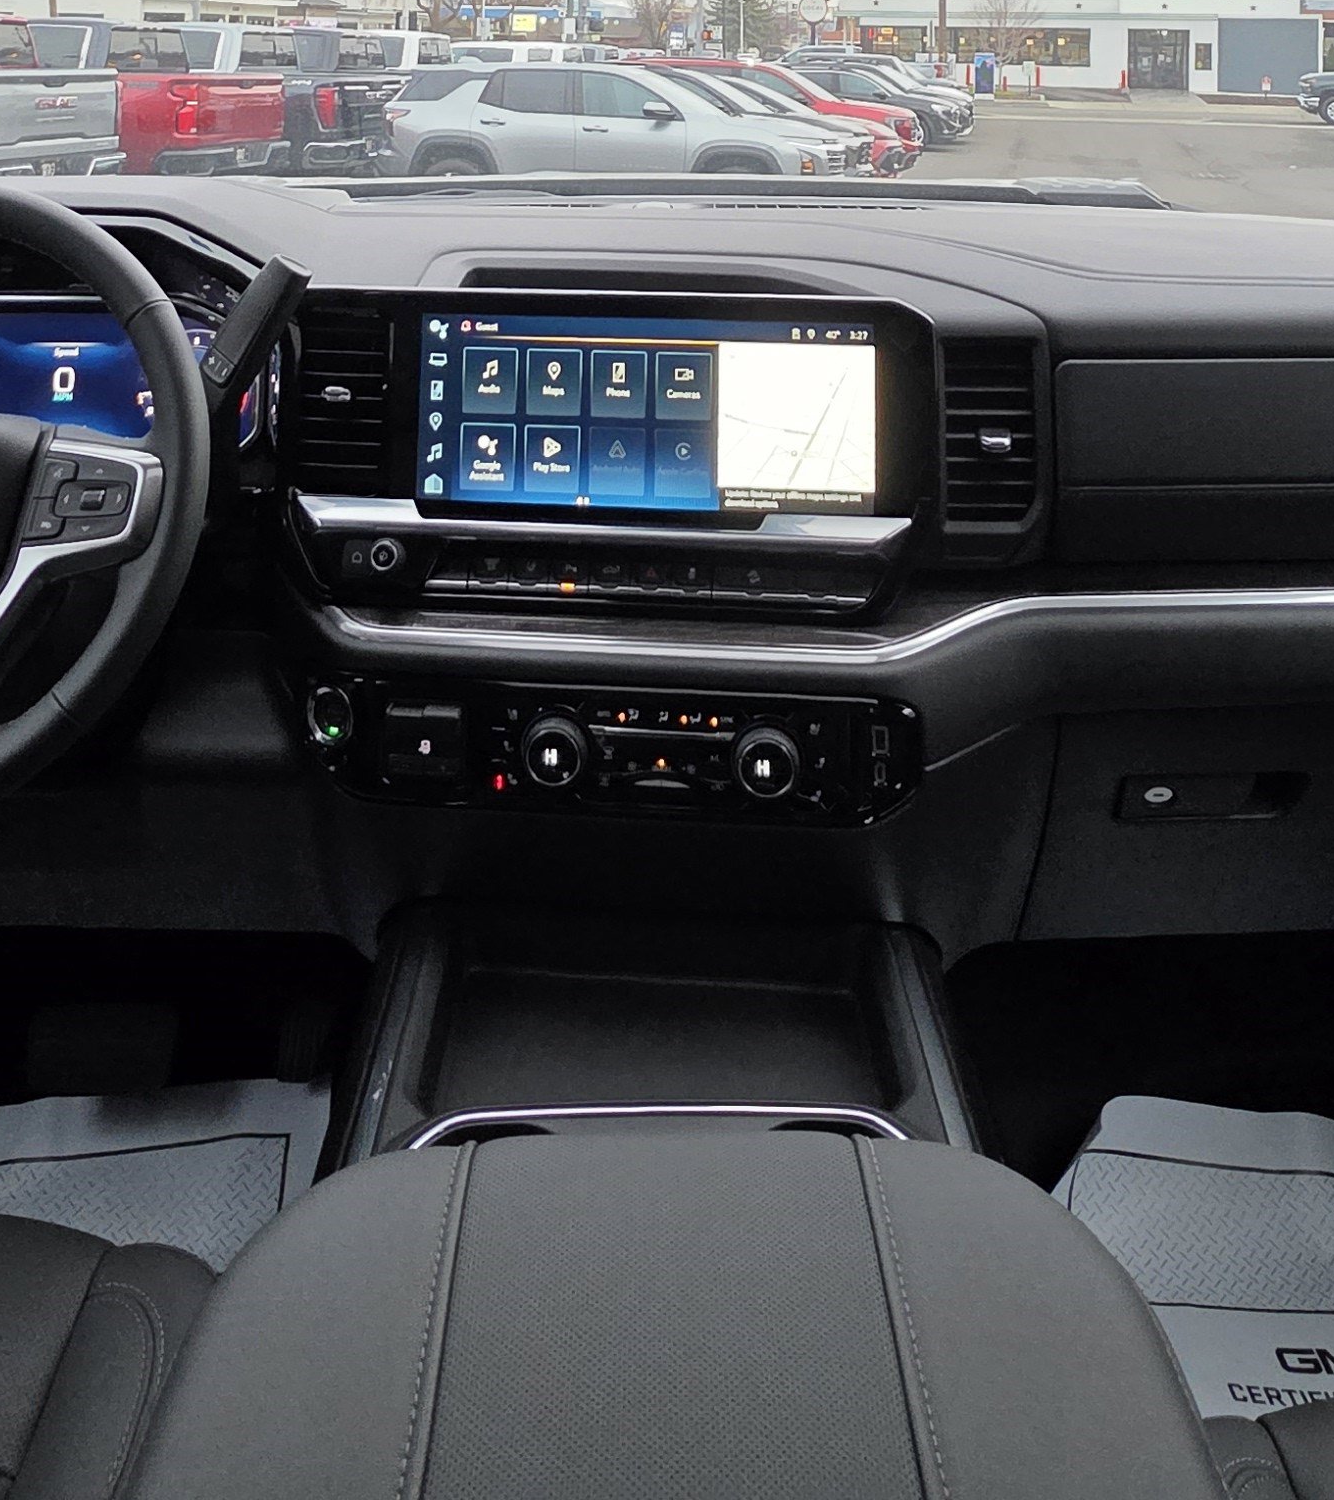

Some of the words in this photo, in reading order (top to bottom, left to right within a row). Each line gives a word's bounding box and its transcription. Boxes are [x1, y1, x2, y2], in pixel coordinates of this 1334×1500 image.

[849, 330, 868, 340] 3:27
[53, 366, 75, 393] 0
[477, 383, 501, 394] Audio
[542, 385, 565, 397] Maps
[605, 387, 631, 398] Phone
[666, 388, 701, 400] Cameras
[52, 392, 74, 401] MPH
[473, 460, 501, 472] Google
[533, 462, 549, 474] Play
[469, 471, 505, 481] Assistant
